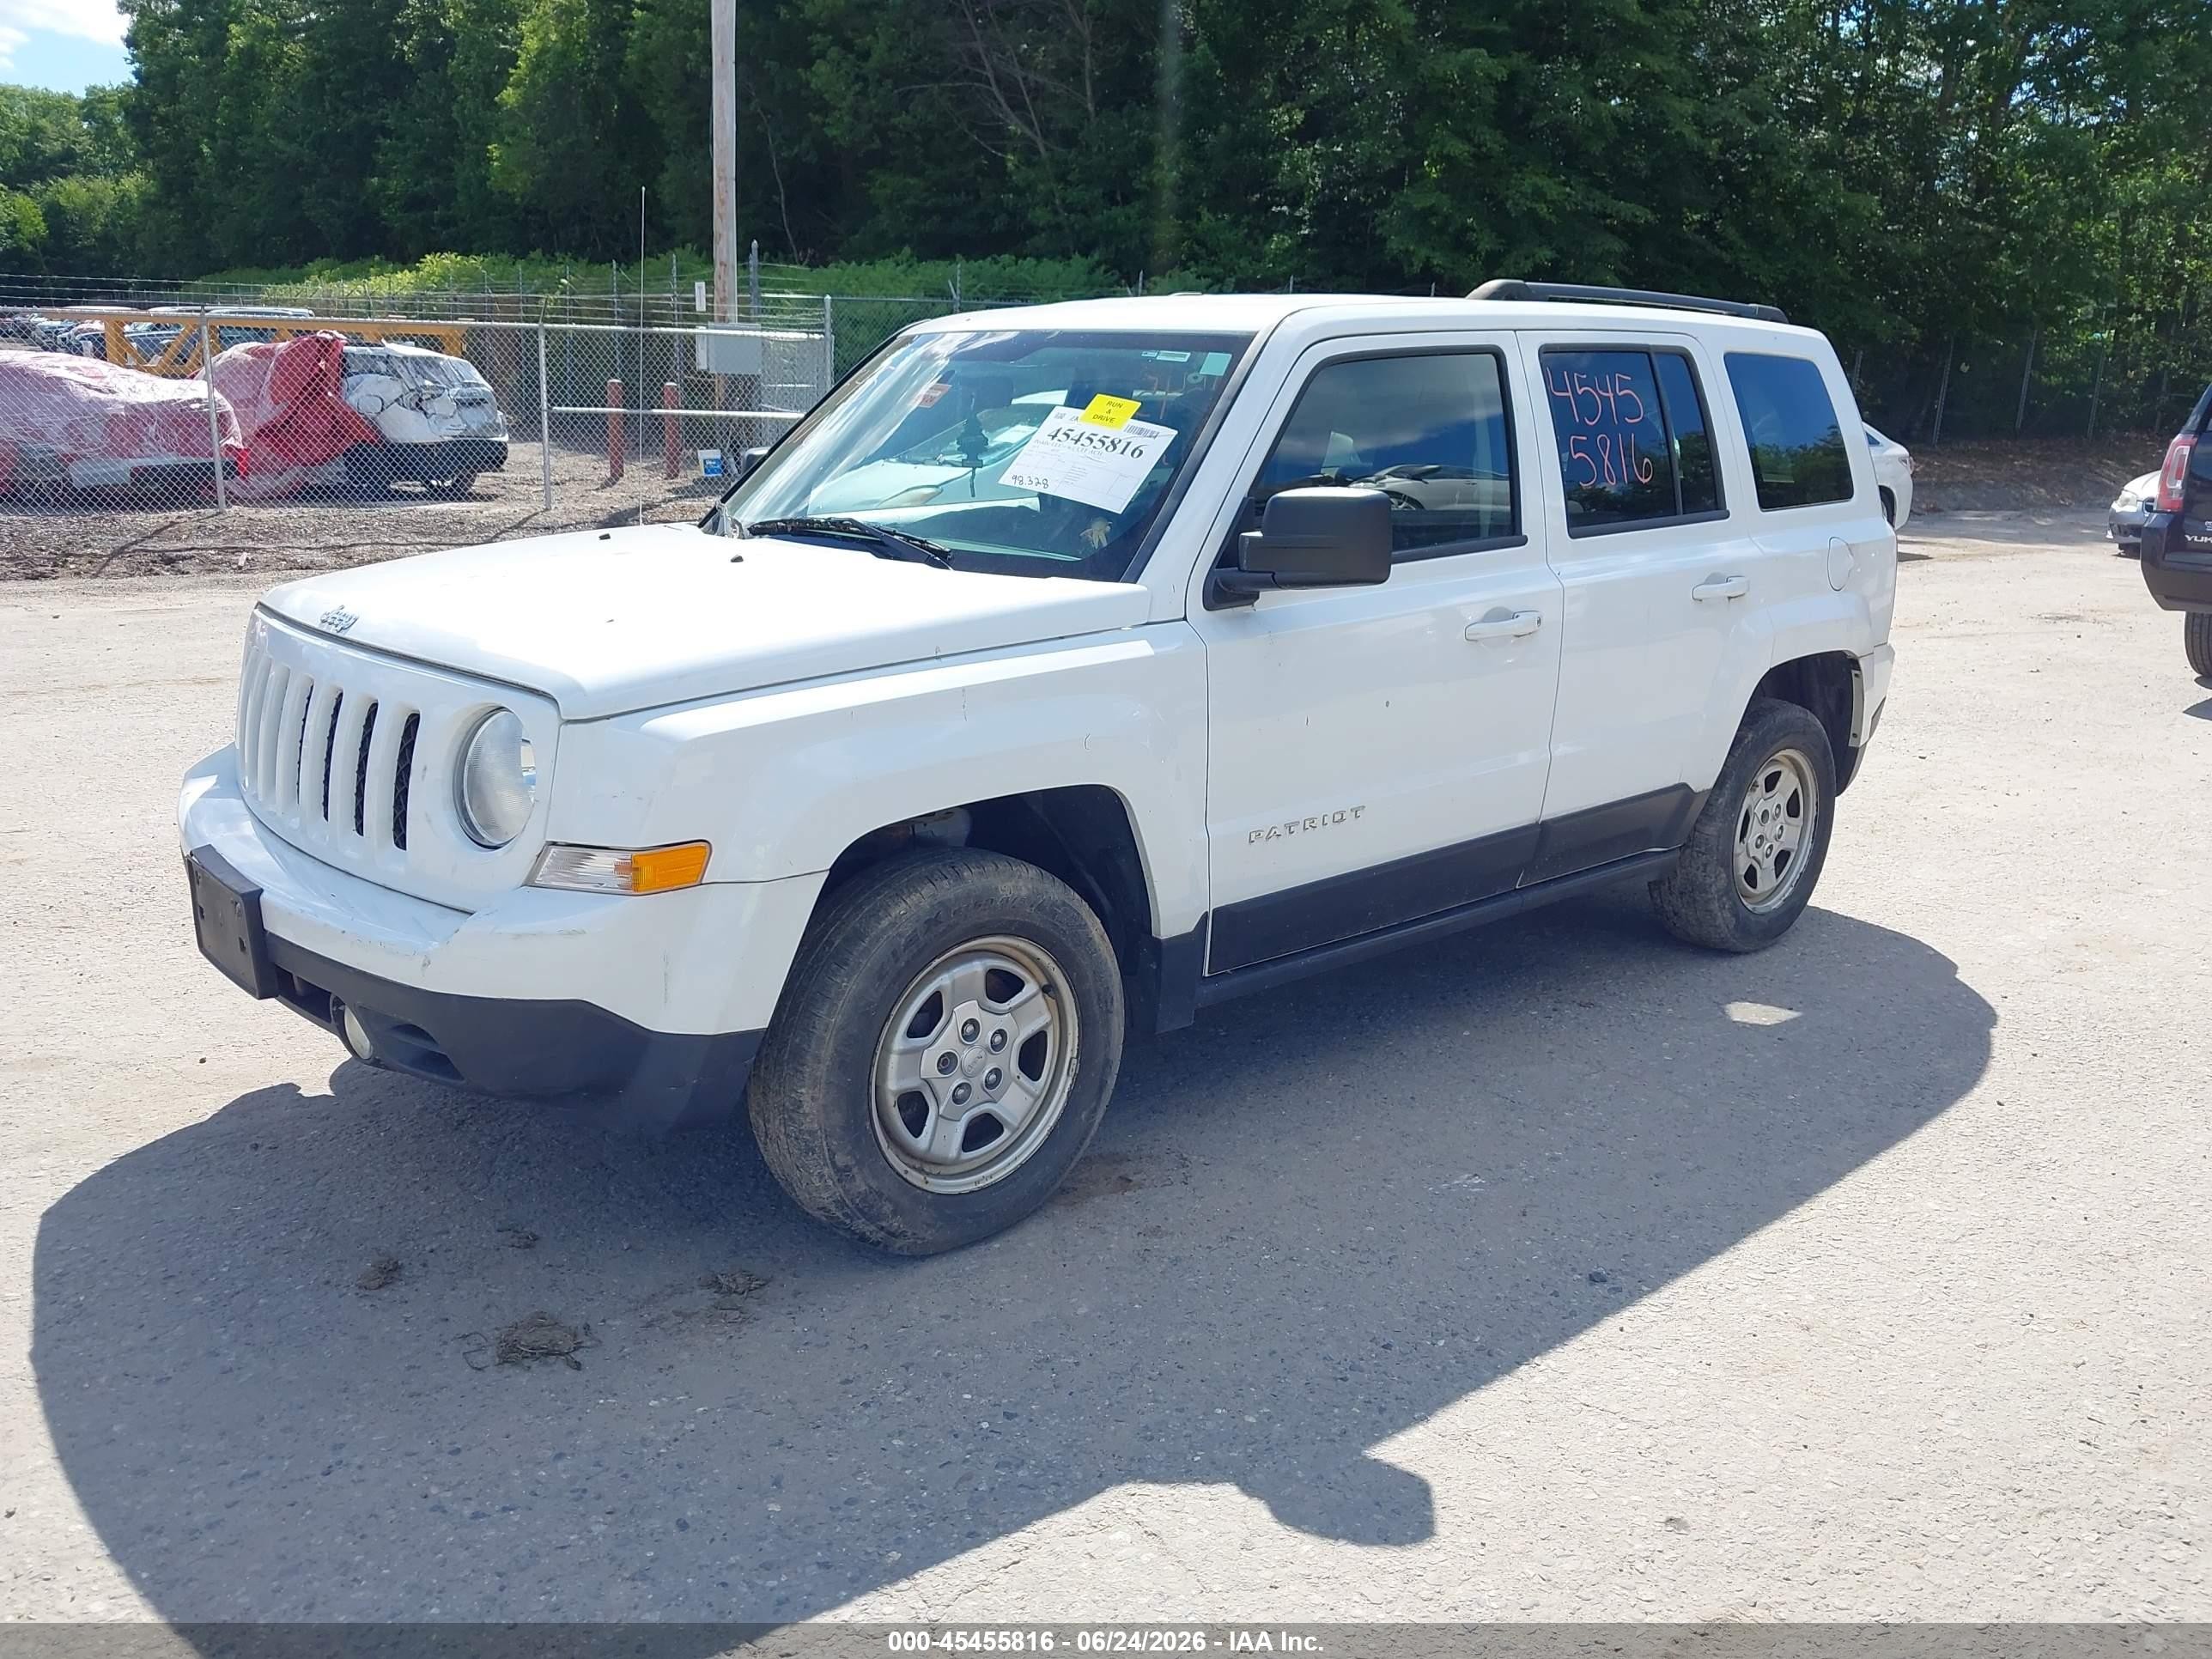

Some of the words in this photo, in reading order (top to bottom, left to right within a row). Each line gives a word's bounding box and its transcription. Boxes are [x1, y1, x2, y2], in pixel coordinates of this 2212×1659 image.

[1547, 367, 1644, 426] 4545
[1091, 414, 1116, 423] DRIVE
[1047, 427, 1148, 459] 45455816
[1571, 433, 1653, 487] 5816
[320, 605, 359, 634] Jeep
[1249, 805, 1366, 843] PATRIOT
